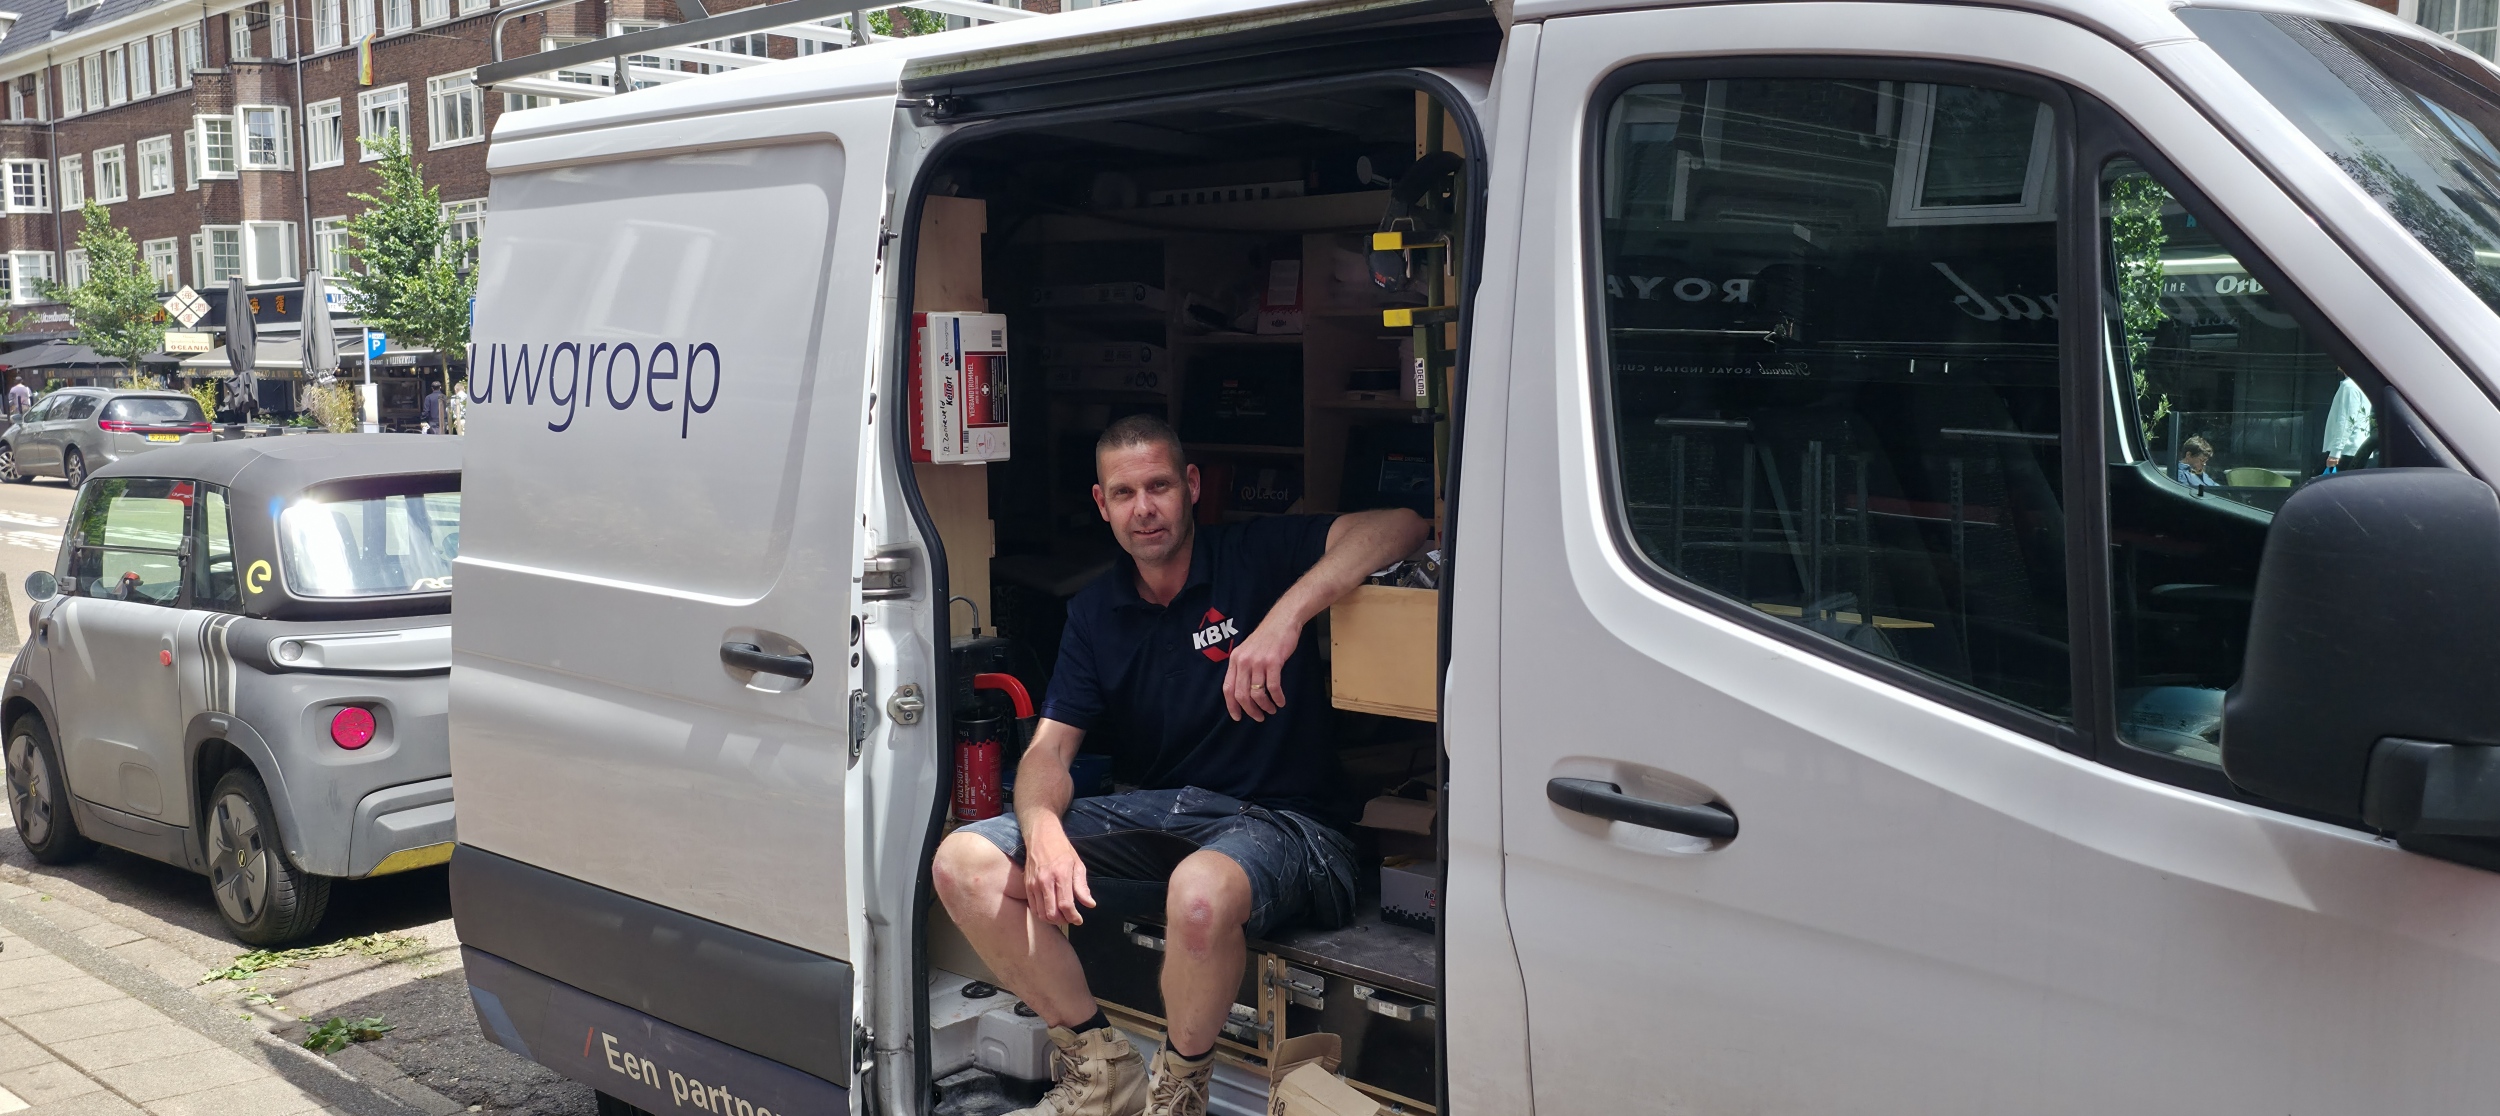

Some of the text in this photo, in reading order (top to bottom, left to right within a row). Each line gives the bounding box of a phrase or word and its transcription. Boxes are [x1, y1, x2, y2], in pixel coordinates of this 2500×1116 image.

[372, 339, 381, 351] P
[469, 341, 721, 439] uwgroep
[945, 376, 953, 406] Kelfort
[966, 362, 975, 418] VERBANDTROMMEL
[1415, 368, 1425, 396] DELMA
[1257, 486, 1289, 501] Lecot
[1192, 617, 1239, 650] KBK
[601, 1031, 782, 1116] Een partn
